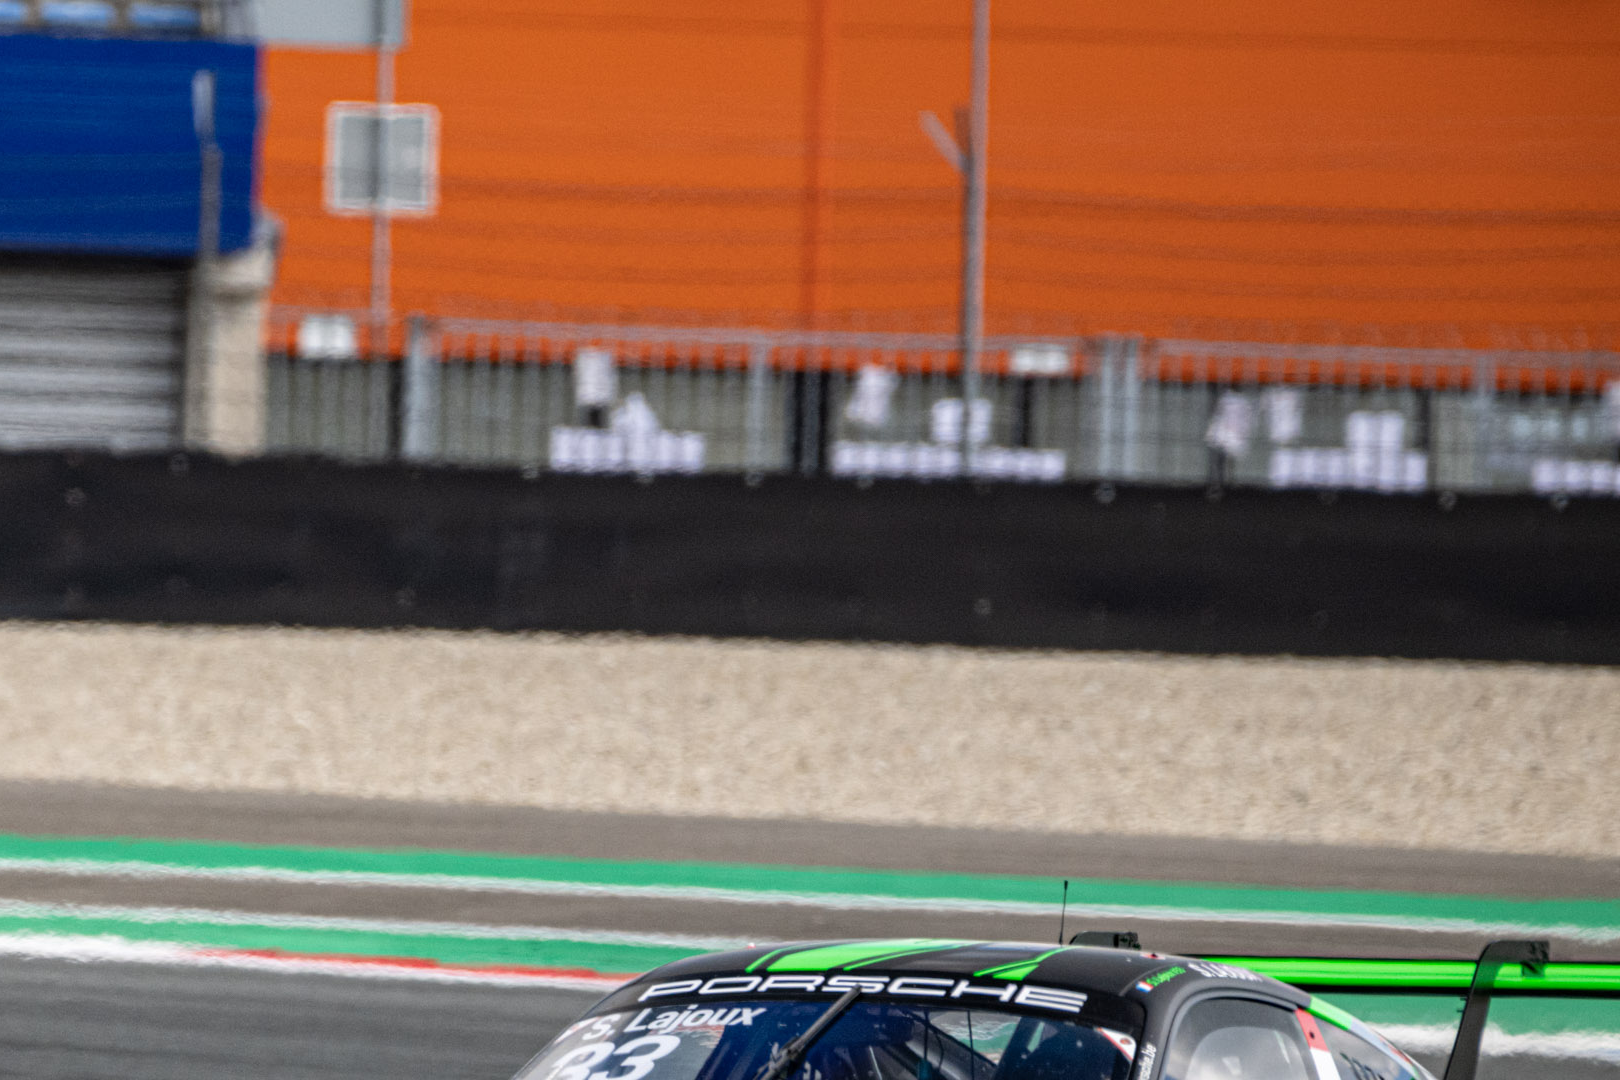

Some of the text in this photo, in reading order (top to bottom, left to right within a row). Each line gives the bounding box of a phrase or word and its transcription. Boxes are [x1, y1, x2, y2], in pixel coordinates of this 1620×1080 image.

[638, 975, 1087, 1013] PORSCHE
[582, 1004, 768, 1040] S. Lajoux
